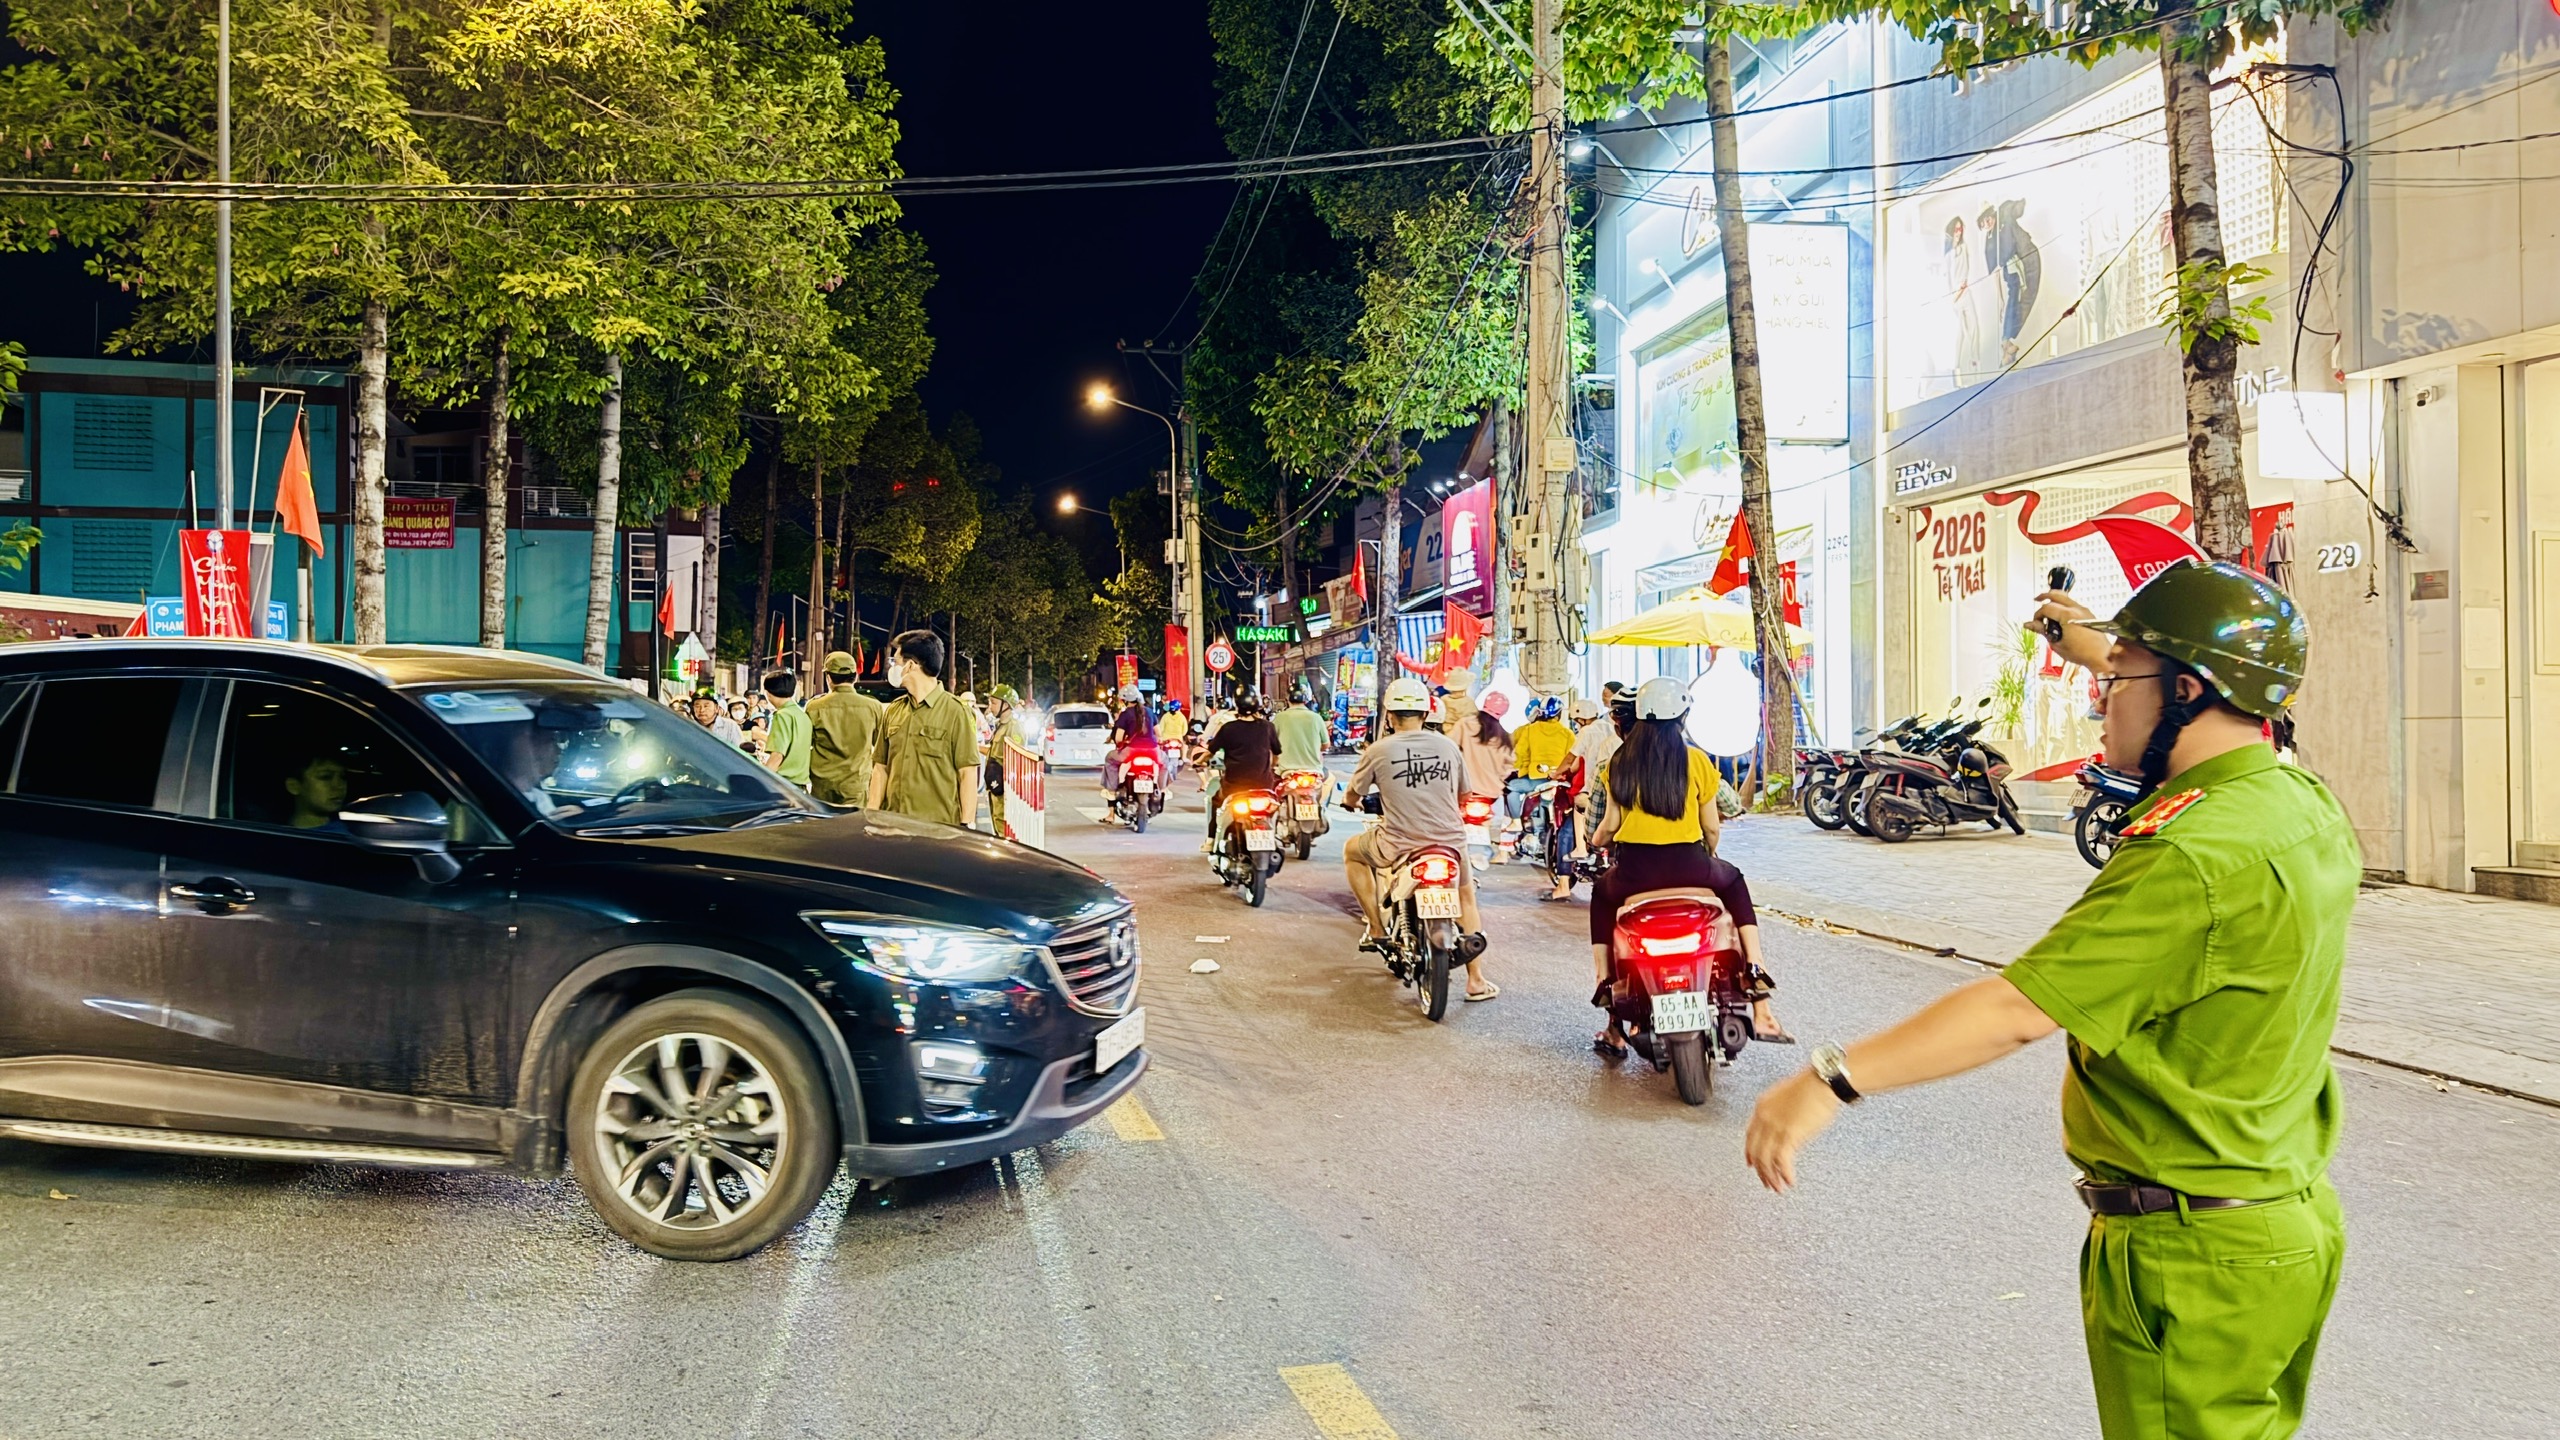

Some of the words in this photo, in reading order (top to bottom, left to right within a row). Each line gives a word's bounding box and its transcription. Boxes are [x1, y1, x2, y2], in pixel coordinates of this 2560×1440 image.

[1895, 467, 1952, 493] ELEVEN
[406, 513, 433, 530] QUẢNG
[434, 514, 450, 529] CÁO
[1933, 511, 1985, 559] 2026
[2318, 546, 2356, 568] 229
[155, 620, 184, 634] PHẠM
[1236, 627, 1288, 641] HASAKI
[1660, 995, 1698, 1014] 65-AA
